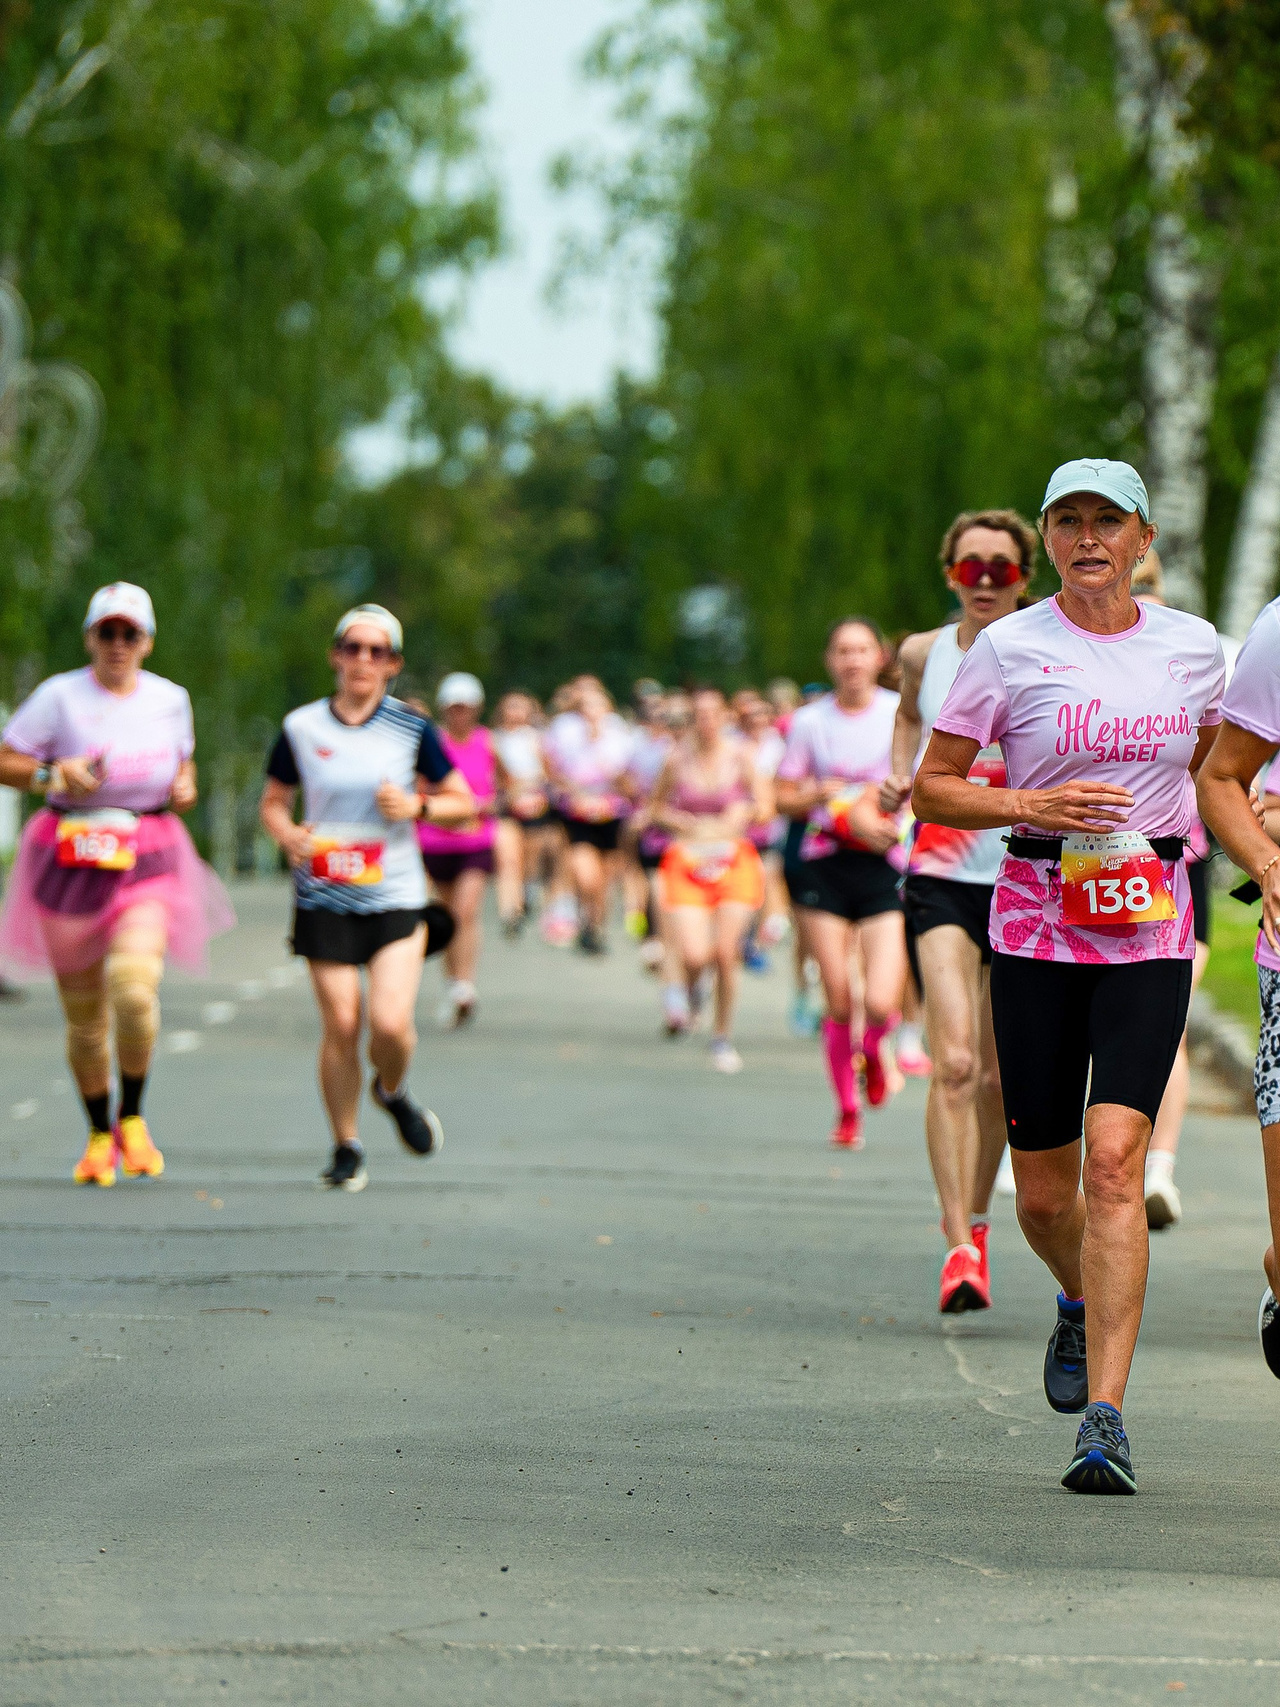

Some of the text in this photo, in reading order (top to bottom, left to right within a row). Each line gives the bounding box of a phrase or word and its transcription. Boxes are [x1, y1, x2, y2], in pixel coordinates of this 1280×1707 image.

[1055, 698, 1193, 757] Женский
[1092, 742, 1166, 764] ЗАБЕГ
[1082, 876, 1153, 914] 138
